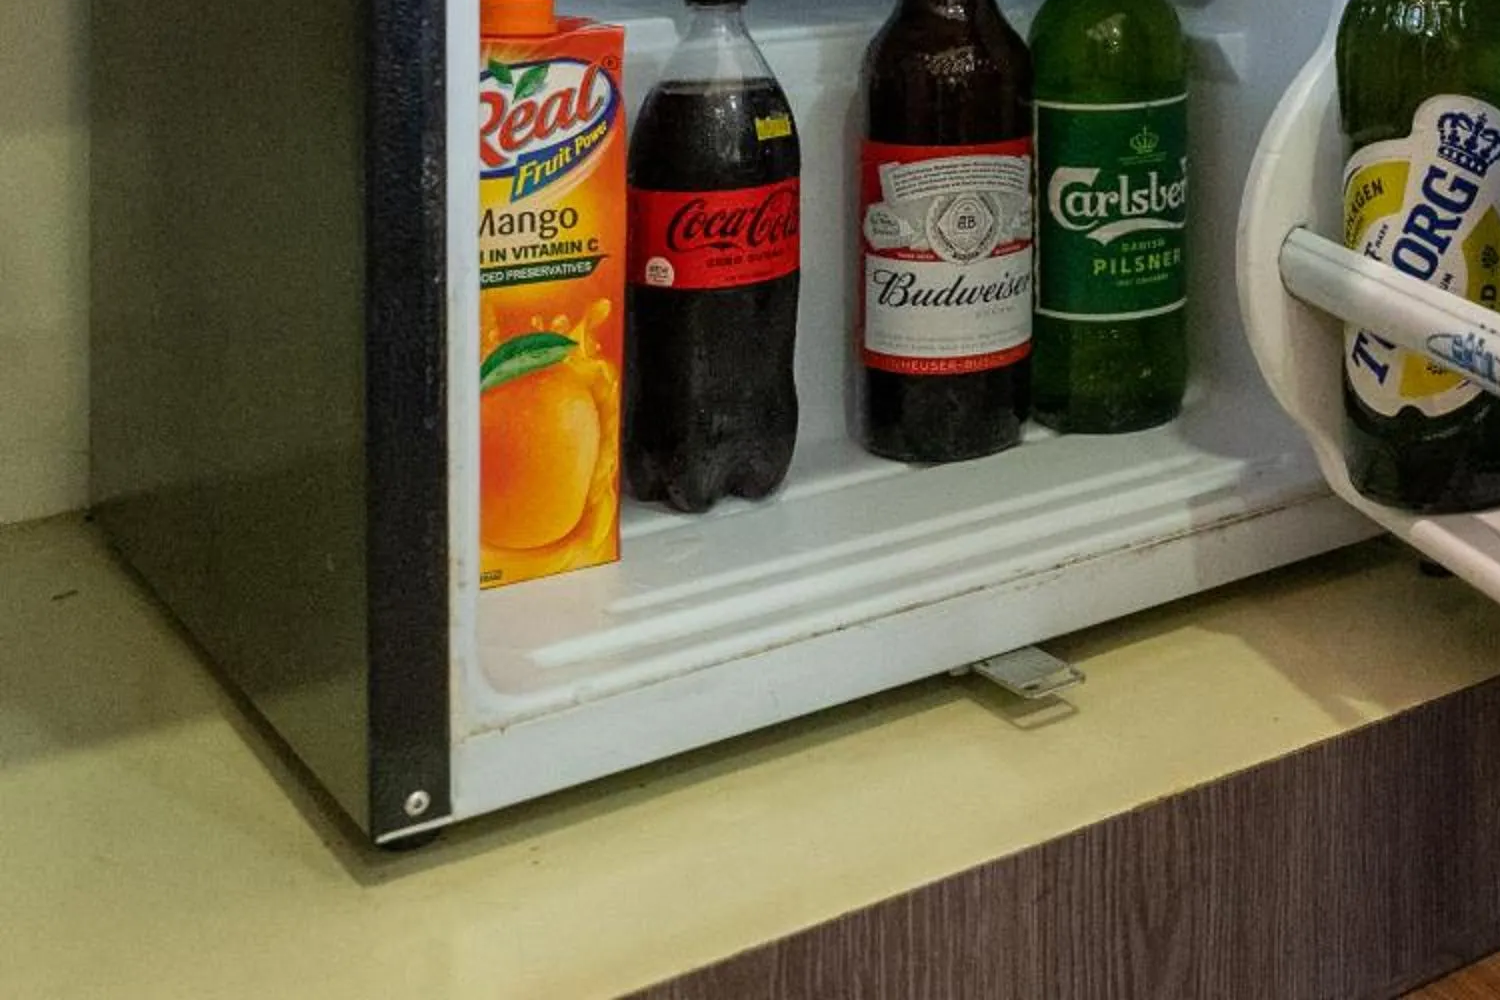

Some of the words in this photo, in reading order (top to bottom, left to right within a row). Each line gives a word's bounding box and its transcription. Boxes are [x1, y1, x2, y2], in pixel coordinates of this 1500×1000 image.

[479, 63, 606, 168] Real
[515, 146, 573, 197] Fruit
[489, 247, 507, 263] IN
[511, 239, 584, 261] VITAMIN
[587, 238, 600, 252] C
[1092, 247, 1182, 276] PILSNER
[506, 260, 593, 281] PRESERVATIVES
[873, 269, 1031, 308] Budweiser
